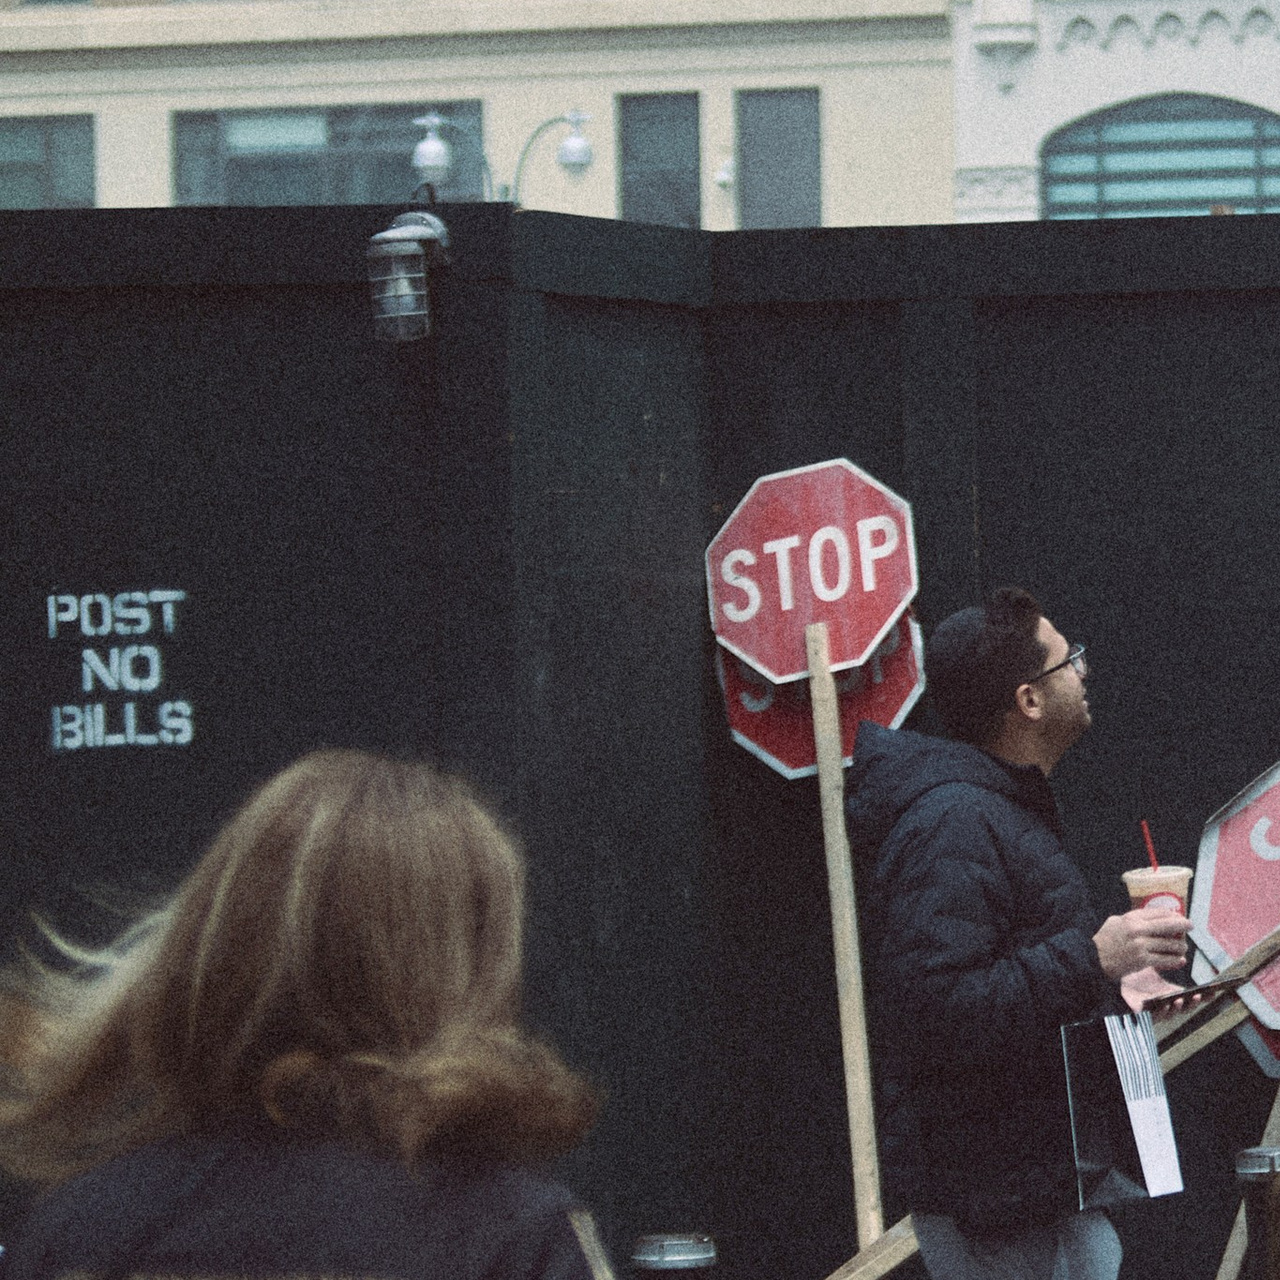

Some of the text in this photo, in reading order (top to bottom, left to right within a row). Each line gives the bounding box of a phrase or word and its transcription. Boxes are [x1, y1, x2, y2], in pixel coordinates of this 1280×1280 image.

[721, 515, 899, 623] STOP
[46, 588, 187, 639] POST
[82, 644, 162, 692] NO
[52, 699, 194, 751] BILLS
